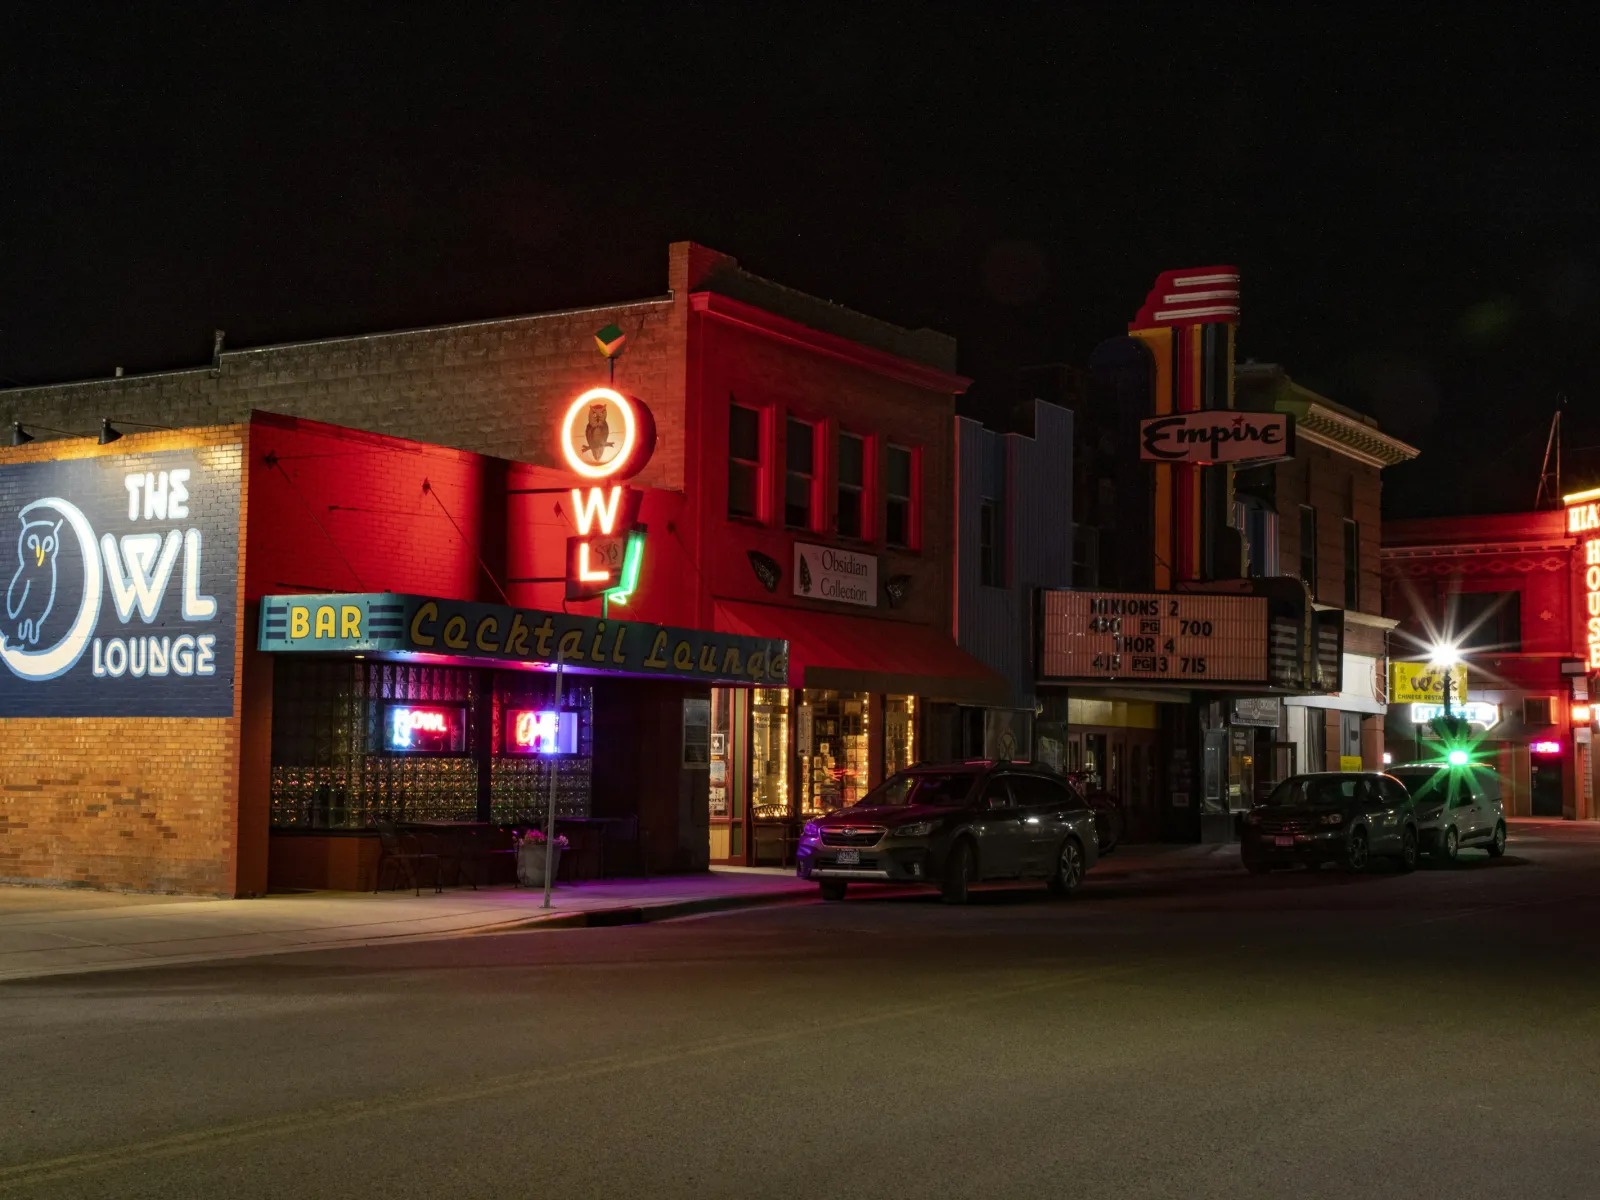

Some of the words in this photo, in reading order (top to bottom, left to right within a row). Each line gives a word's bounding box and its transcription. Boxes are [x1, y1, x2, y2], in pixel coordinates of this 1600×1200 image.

[125, 468, 191, 521] THE
[1568, 503, 1600, 533] HIA
[822, 550, 868, 576] Obsidian
[820, 577, 868, 602] Collection
[1170, 601, 1178, 615] 2
[289, 605, 363, 640] BAR
[409, 600, 628, 664] Cocktail
[1142, 621, 1158, 633] PG
[1179, 620, 1212, 637] 700
[92, 635, 216, 677] LOUNGE
[1113, 636, 1155, 653] THOR
[1164, 639, 1175, 653] 4
[1180, 658, 1206, 674] 715
